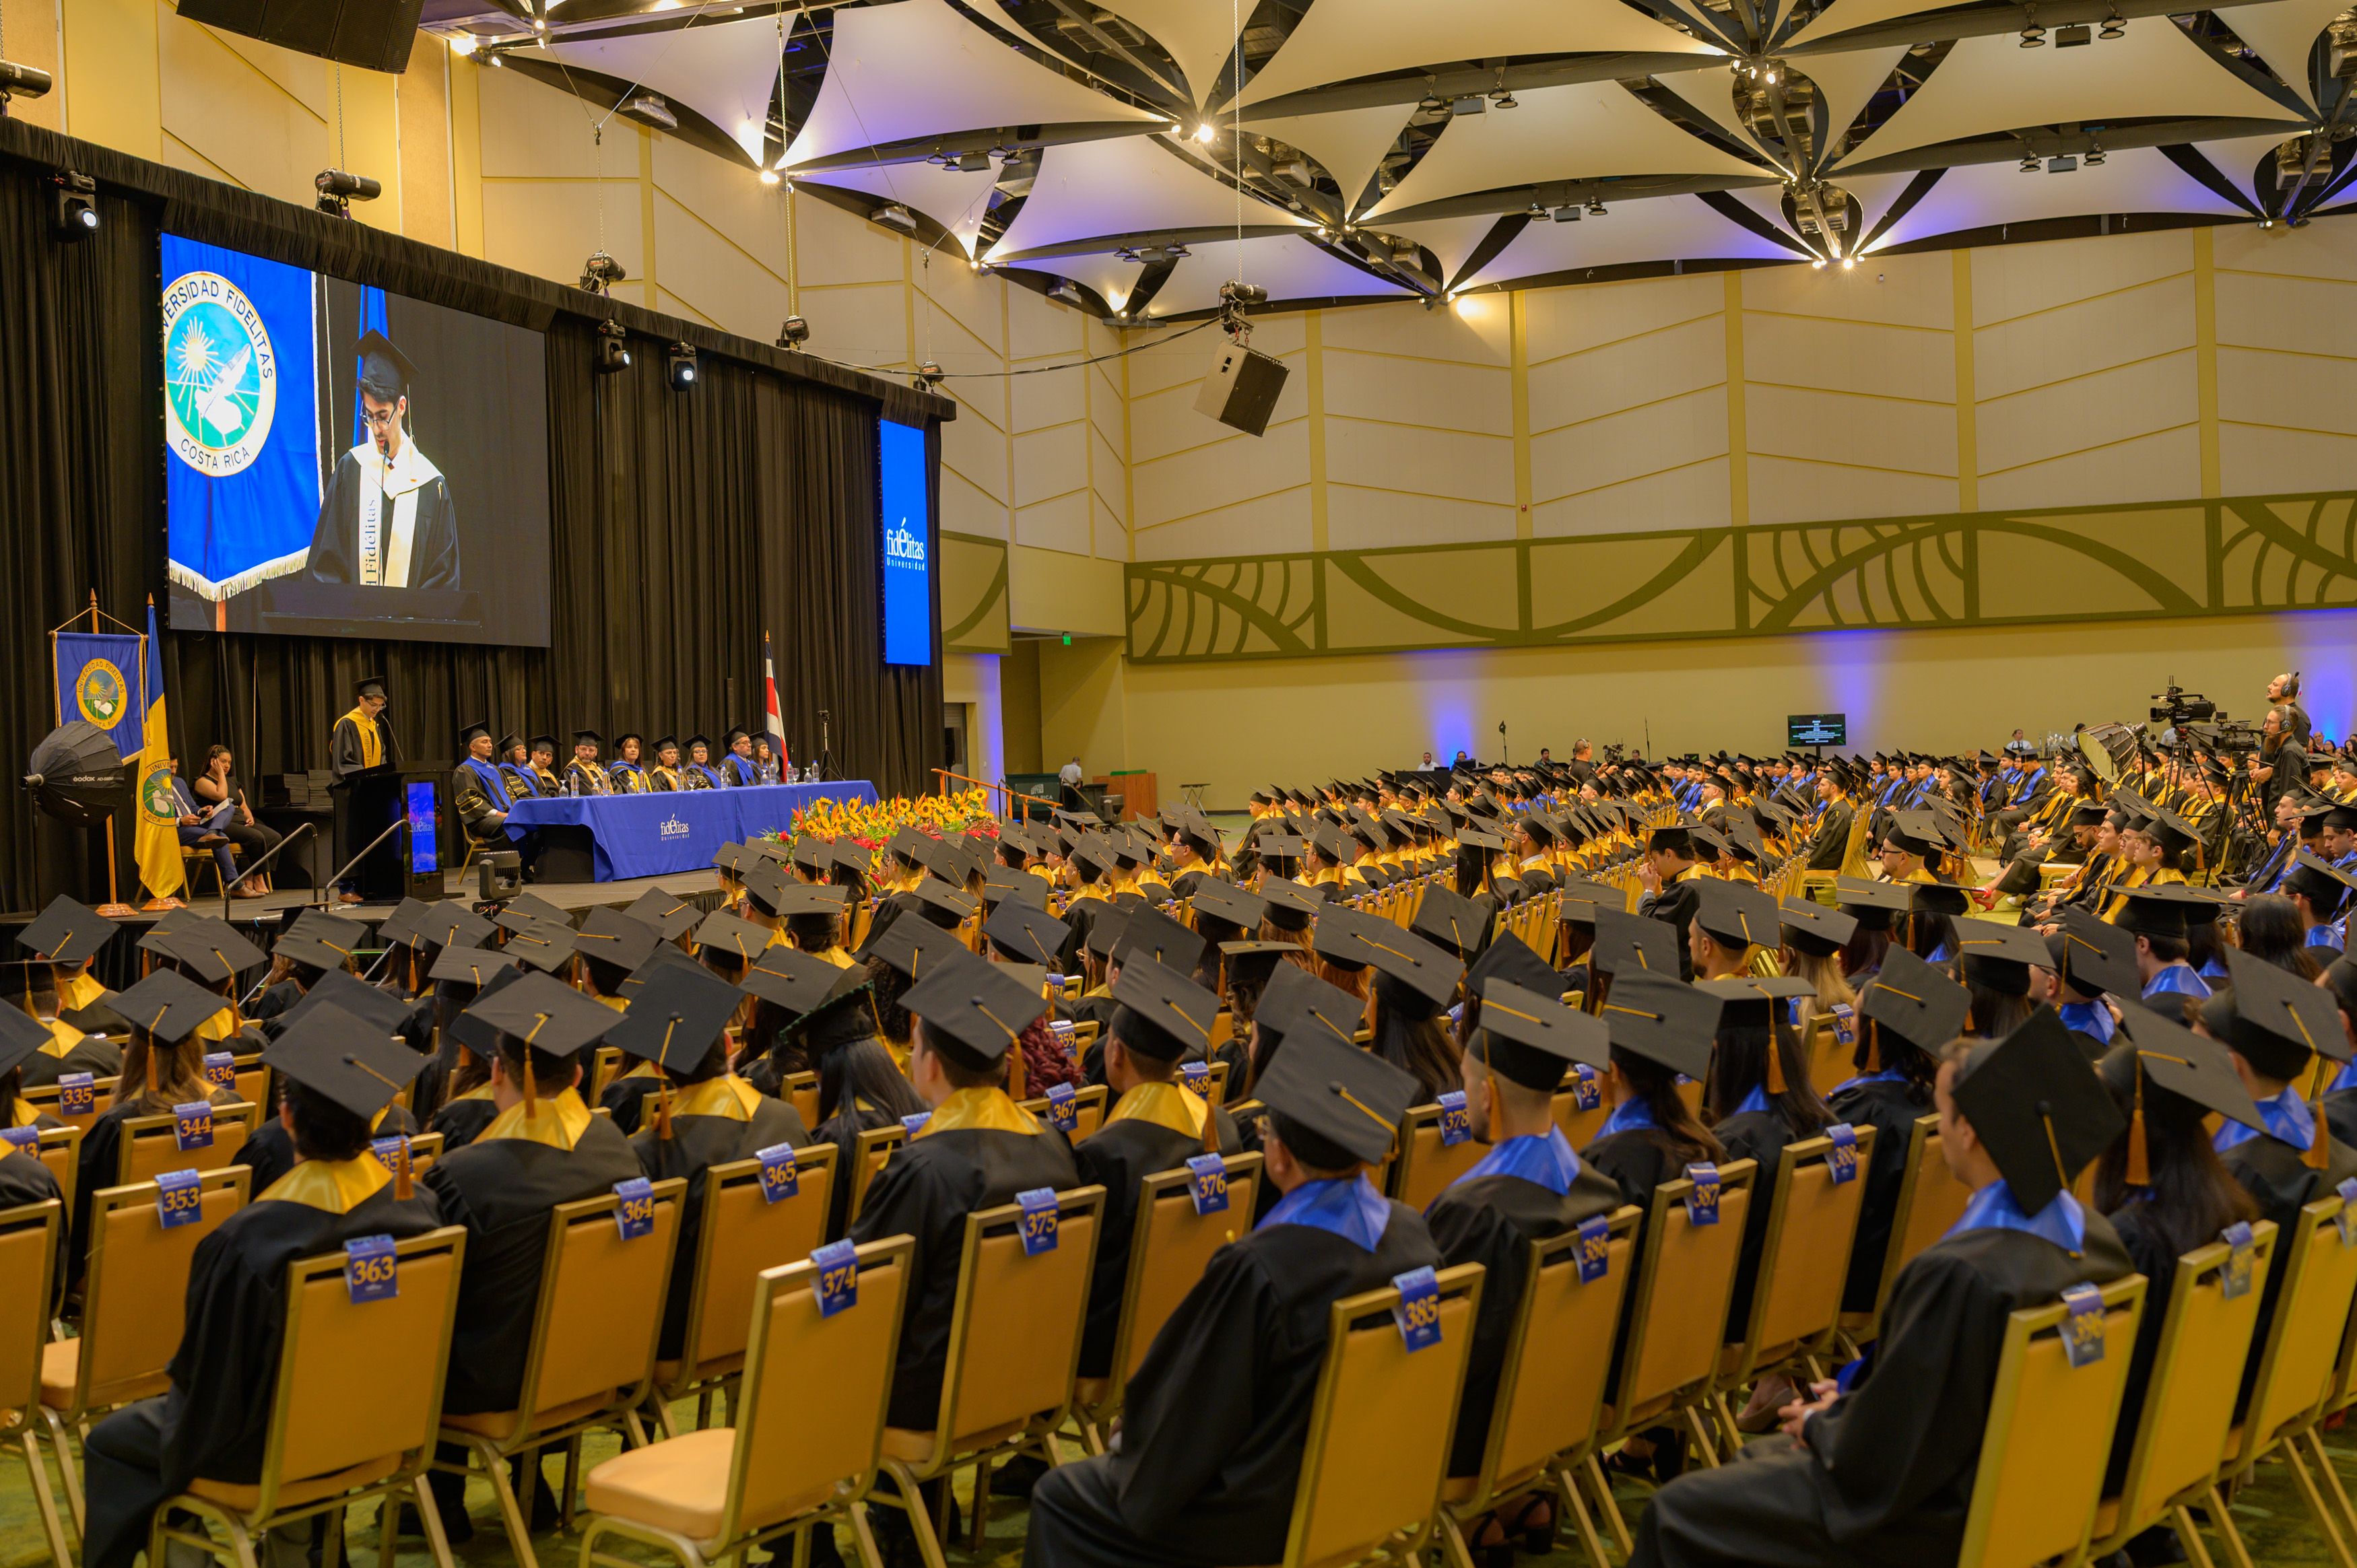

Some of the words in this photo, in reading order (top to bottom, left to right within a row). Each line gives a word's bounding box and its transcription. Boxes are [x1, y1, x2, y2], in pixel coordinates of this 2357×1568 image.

[162, 279, 219, 337] VERSIDAD
[226, 288, 273, 379] FIDELITAS
[180, 438, 218, 469] COSTA
[224, 446, 251, 469] RICA
[365, 500, 377, 574] Fidélitas
[886, 517, 924, 560] fidélitas
[886, 557, 925, 571] Universidad
[77, 660, 104, 693] UNIVERSIDAD
[105, 662, 125, 693] FIDELITAS
[661, 813, 689, 835] fidélitas
[208, 1065, 234, 1083] 336
[63, 1087, 93, 1105] 335
[1054, 1098, 1076, 1122] 367
[1445, 1108, 1469, 1130] 378
[180, 1116, 212, 1137] 344
[379, 1151, 401, 1171] 35
[766, 1161, 797, 1188] 365
[1199, 1171, 1226, 1198] 376
[1694, 1183, 1720, 1208] 387
[163, 1187, 199, 1212] 353
[623, 1196, 654, 1223] 364
[1026, 1209, 1057, 1237] 375
[1583, 1233, 1608, 1264] 386
[352, 1255, 395, 1285] 363
[822, 1264, 856, 1298] 374
[1405, 1295, 1438, 1332] 385
